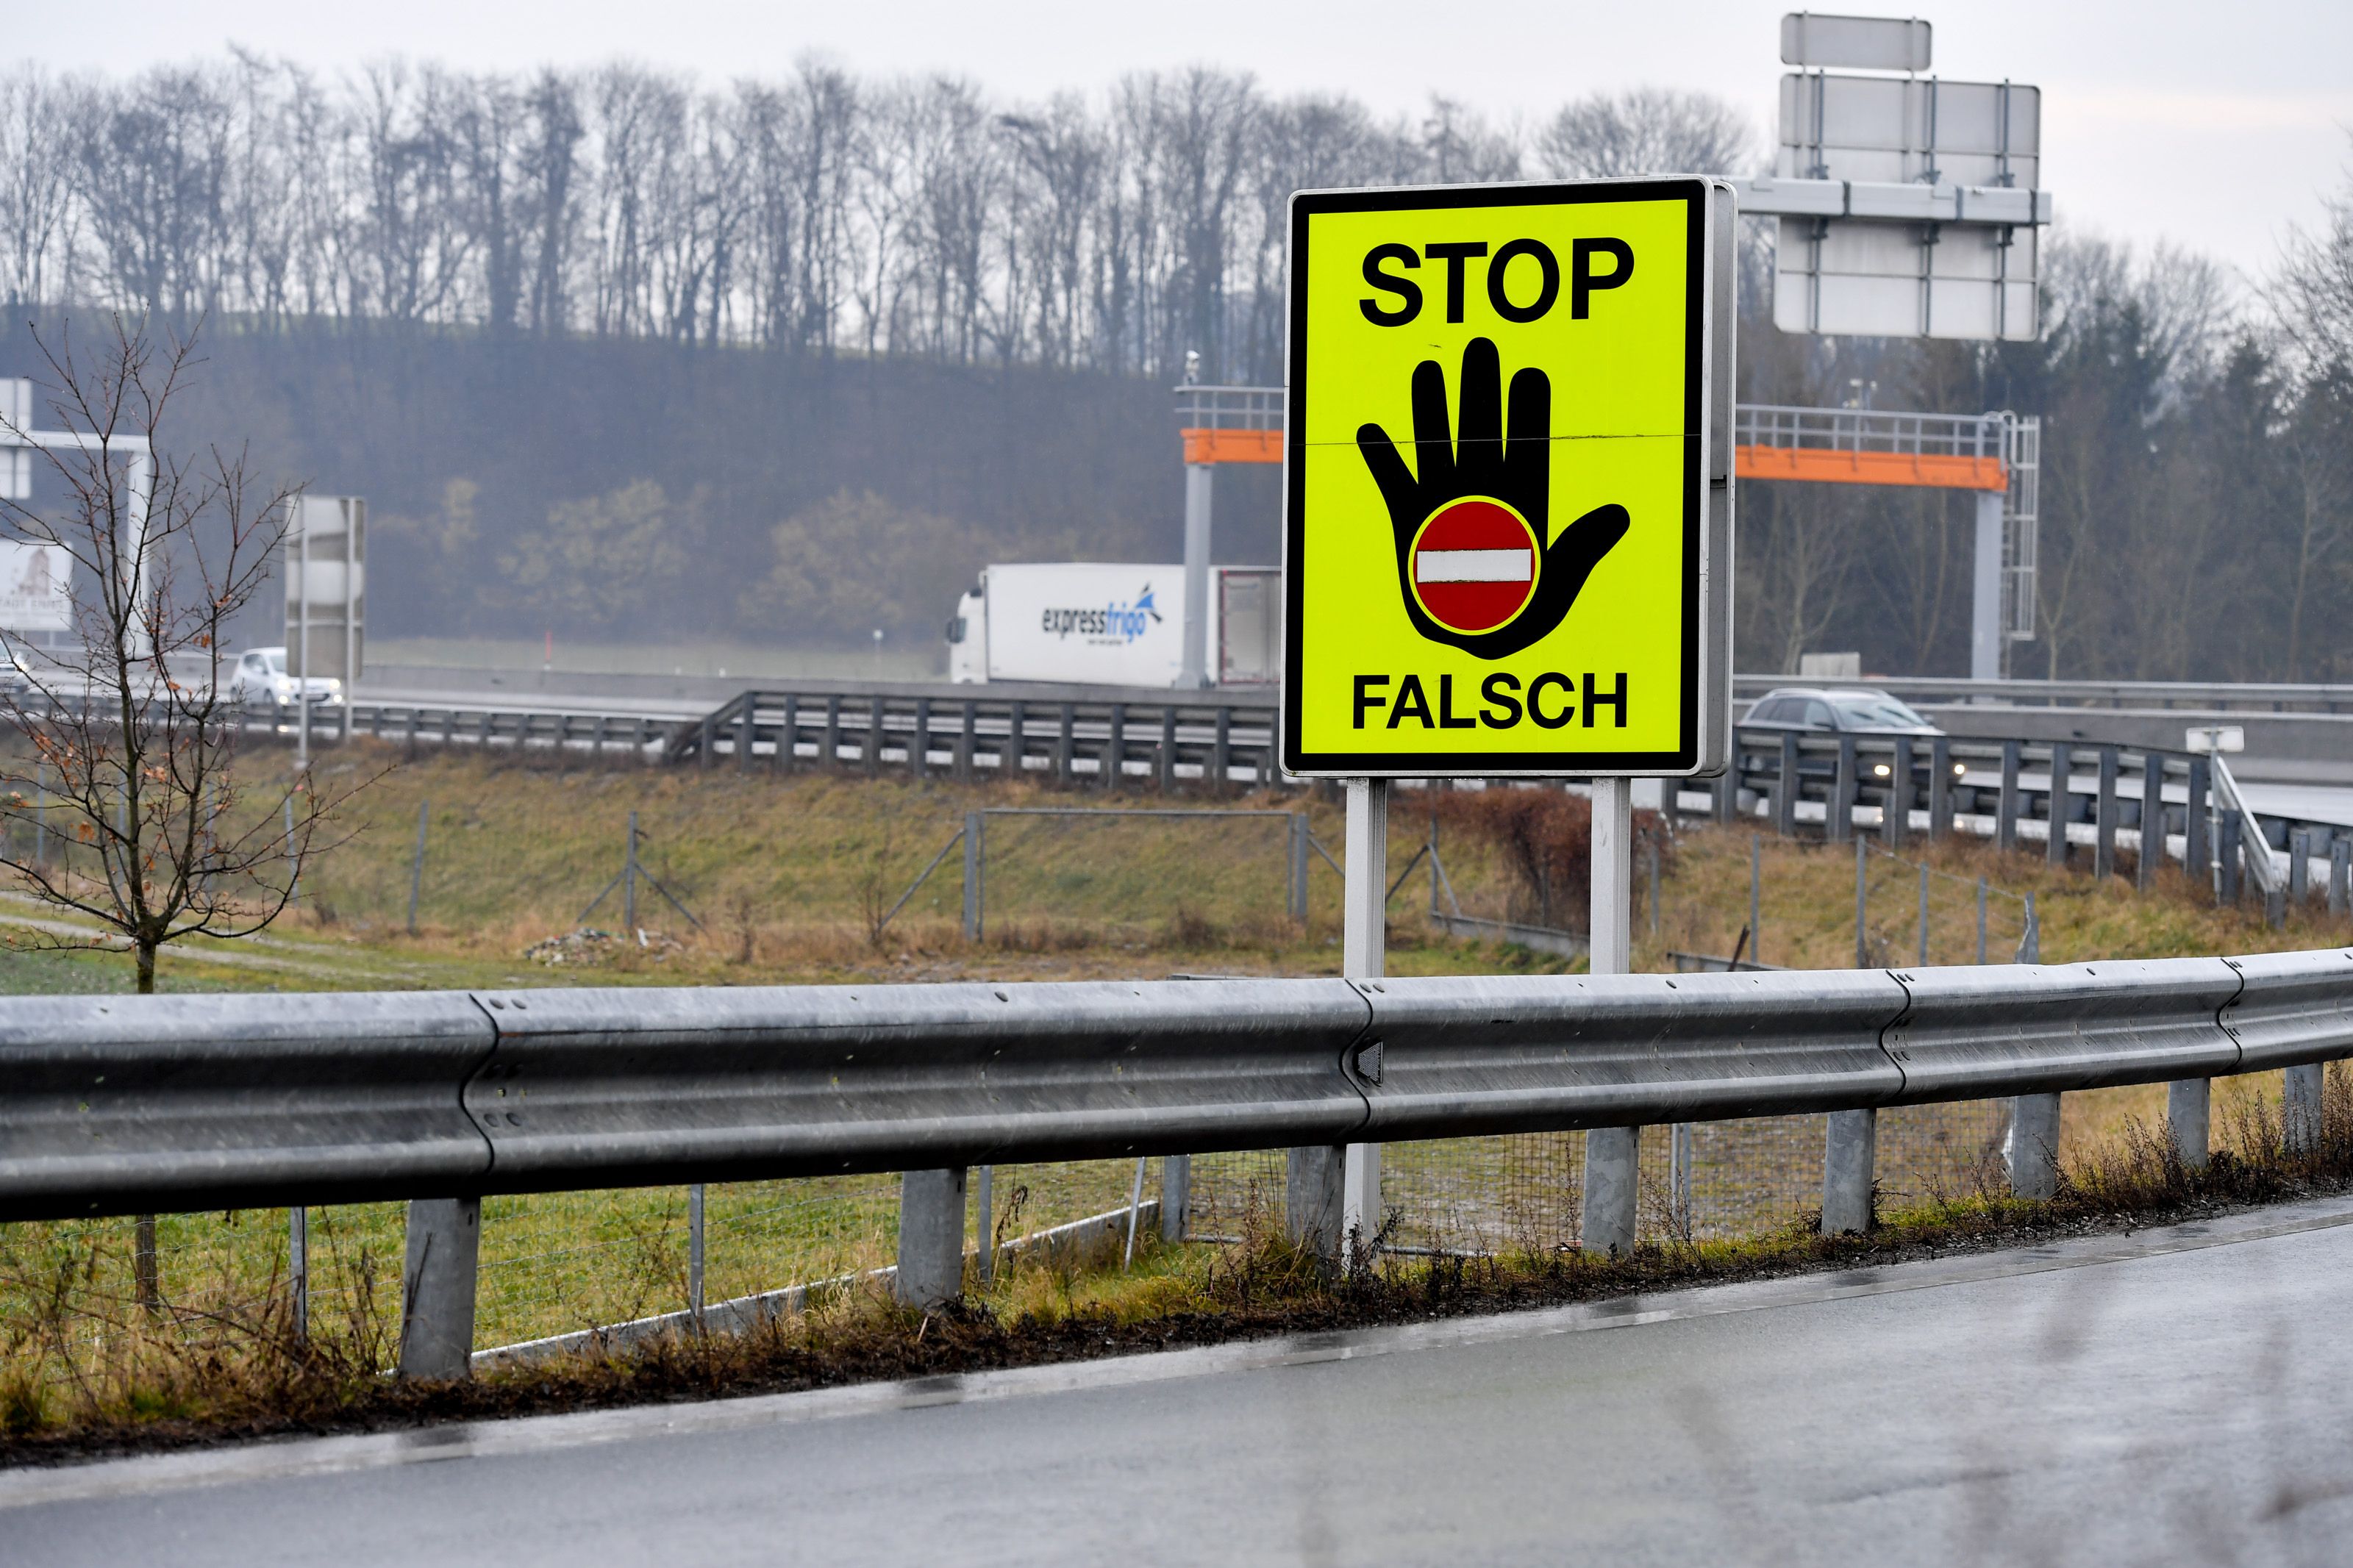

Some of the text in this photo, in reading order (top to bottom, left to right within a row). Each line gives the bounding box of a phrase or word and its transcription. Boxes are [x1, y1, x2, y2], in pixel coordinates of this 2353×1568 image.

[1360, 237, 1635, 328] STOP
[1043, 601, 1146, 643] expressfrigo
[1352, 672, 1628, 730] FALSCH
